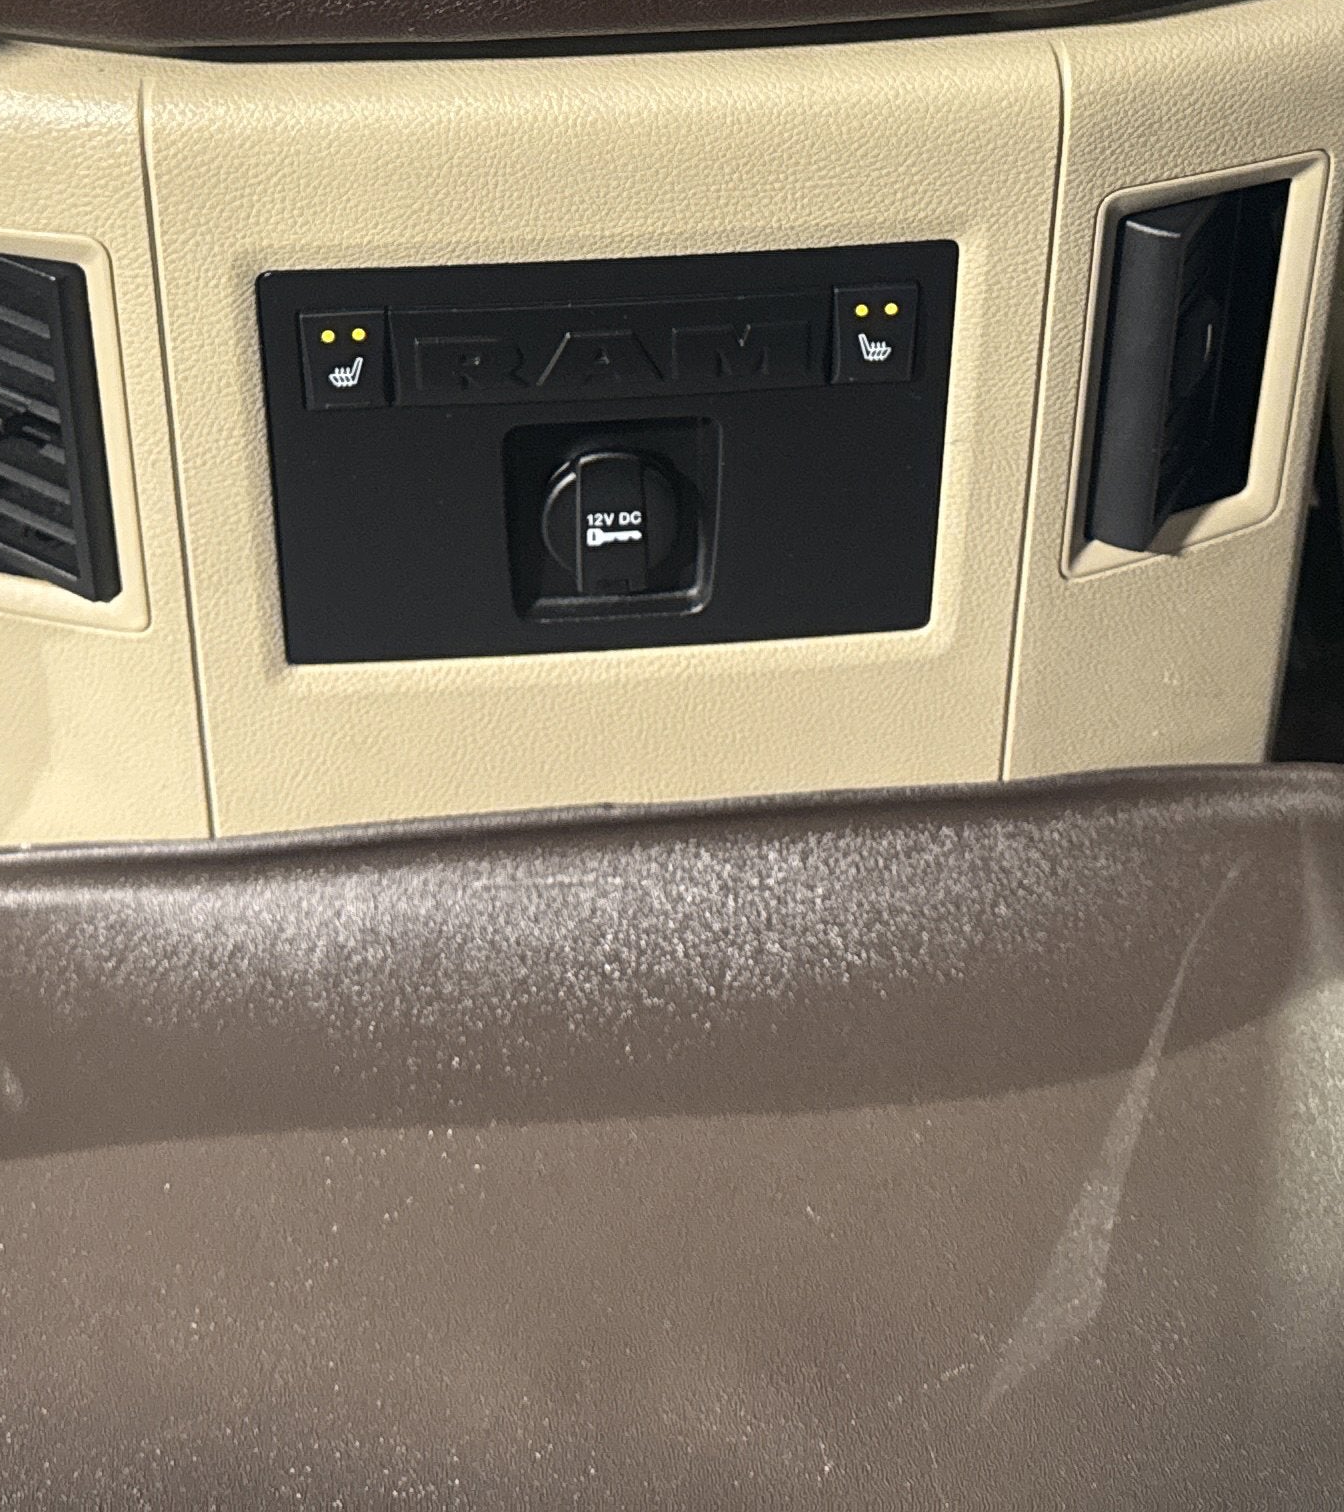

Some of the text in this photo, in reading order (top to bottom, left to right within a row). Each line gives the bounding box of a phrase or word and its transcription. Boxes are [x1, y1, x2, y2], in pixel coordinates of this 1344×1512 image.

[413, 321, 812, 390] RAM
[586, 510, 642, 527] 12V DC
